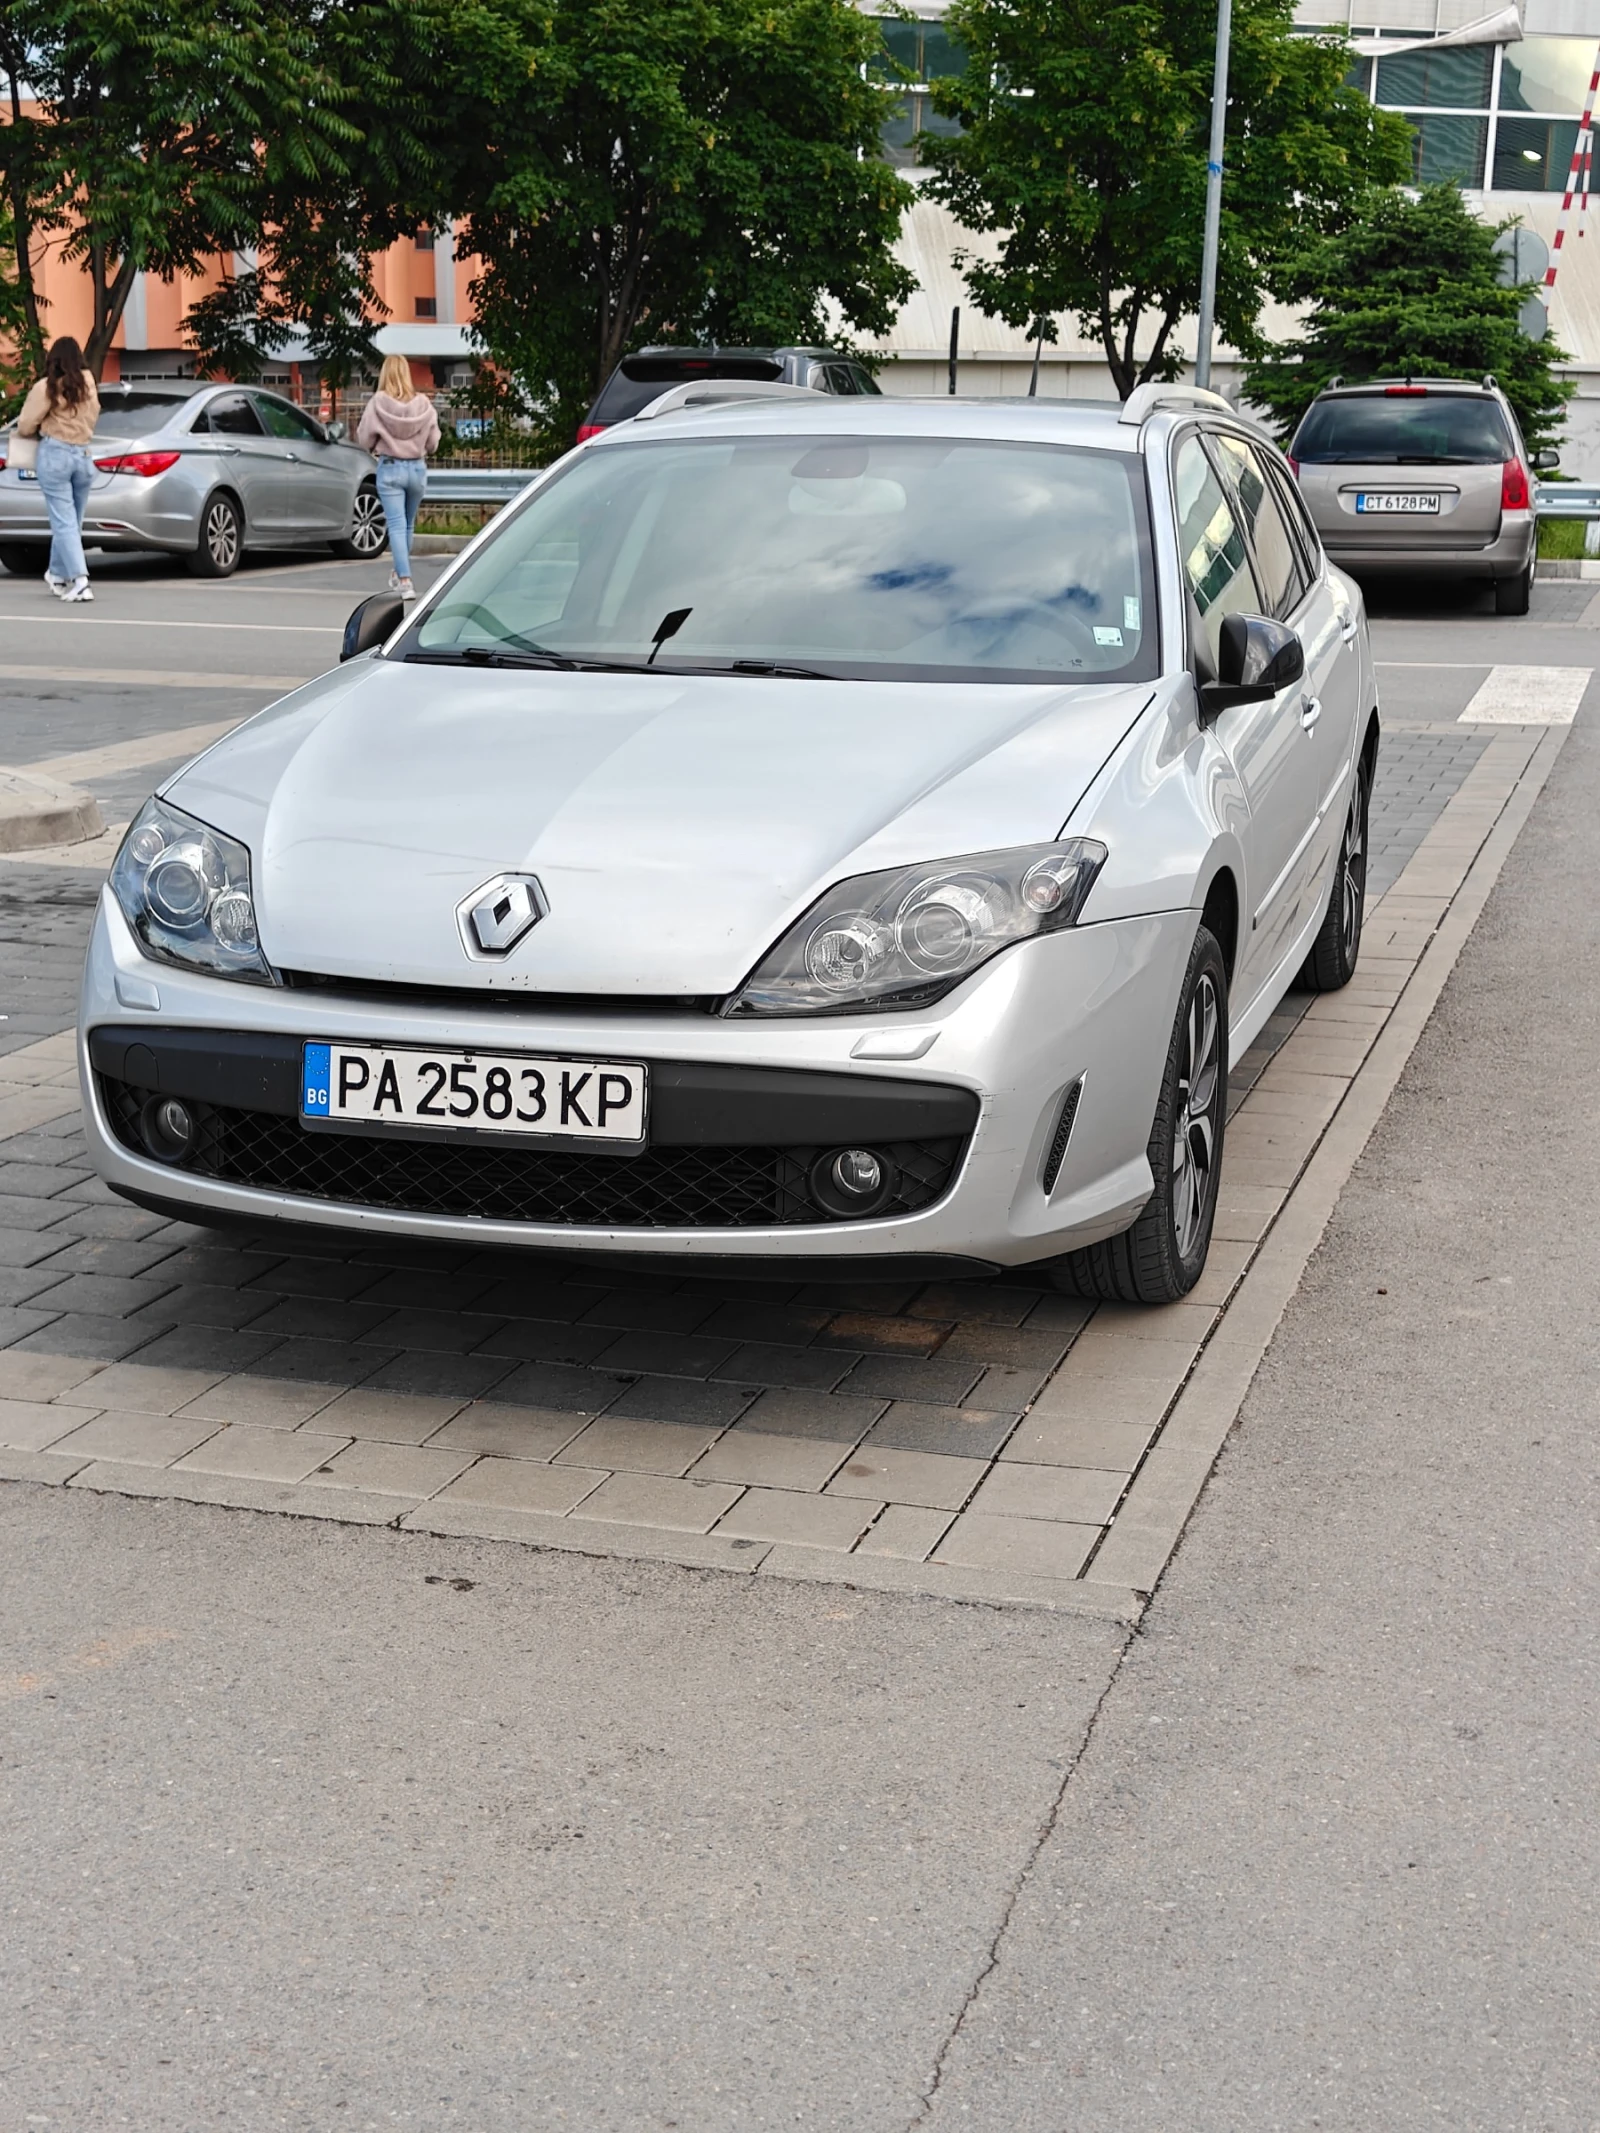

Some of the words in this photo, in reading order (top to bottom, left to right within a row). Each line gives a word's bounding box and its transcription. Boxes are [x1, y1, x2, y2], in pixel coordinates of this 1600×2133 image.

[1366, 496, 1384, 509] CT
[1385, 496, 1417, 509] 6128
[1420, 496, 1437, 509] PM
[307, 1087, 328, 1105] BG
[338, 1055, 403, 1113] PA
[416, 1061, 547, 1122] 2583
[560, 1071, 633, 1128] KP
